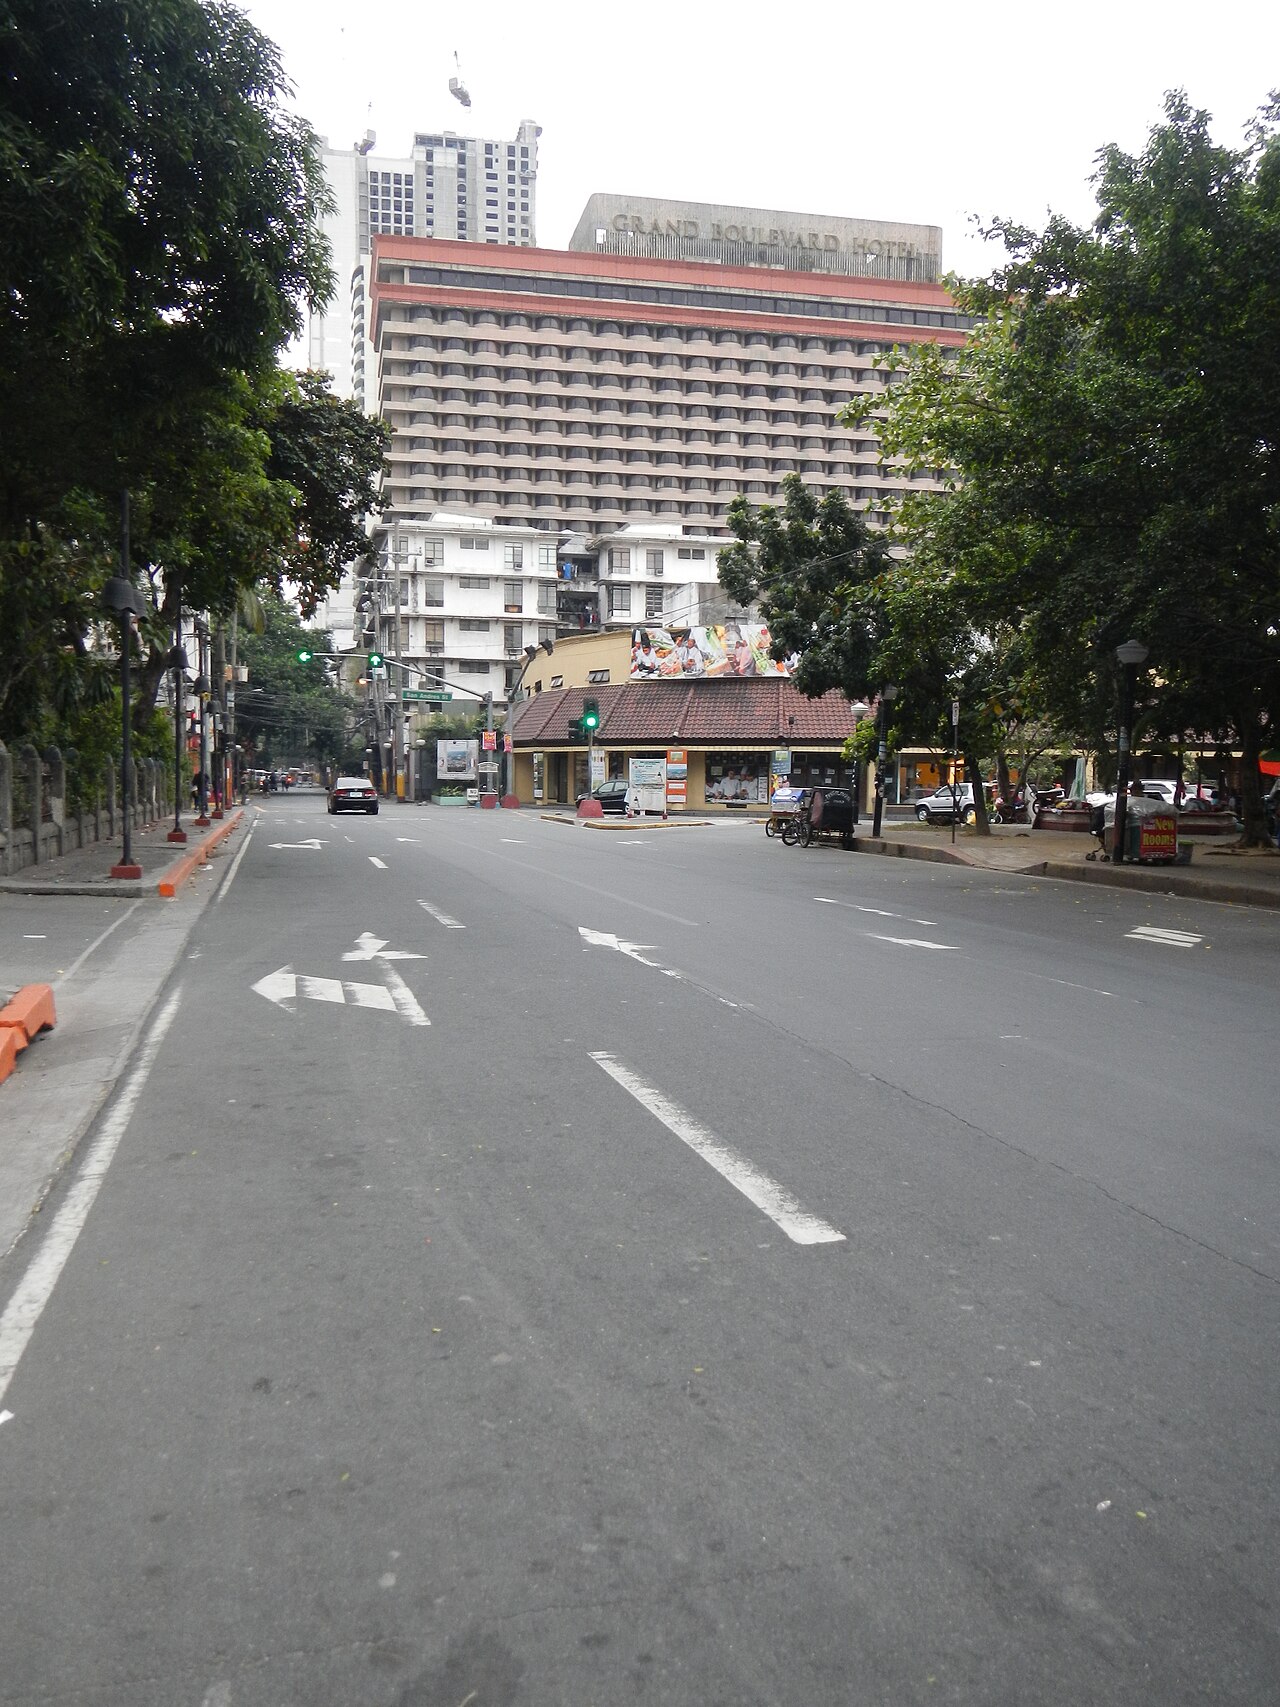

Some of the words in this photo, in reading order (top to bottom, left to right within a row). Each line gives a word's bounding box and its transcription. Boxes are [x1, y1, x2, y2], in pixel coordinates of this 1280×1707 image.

[612, 213, 699, 239] GRAND
[710, 222, 841, 253] BOULEVARD
[852, 236, 920, 259] HOTEL
[1155, 817, 1174, 831] New
[1143, 832, 1175, 846] Rooms
